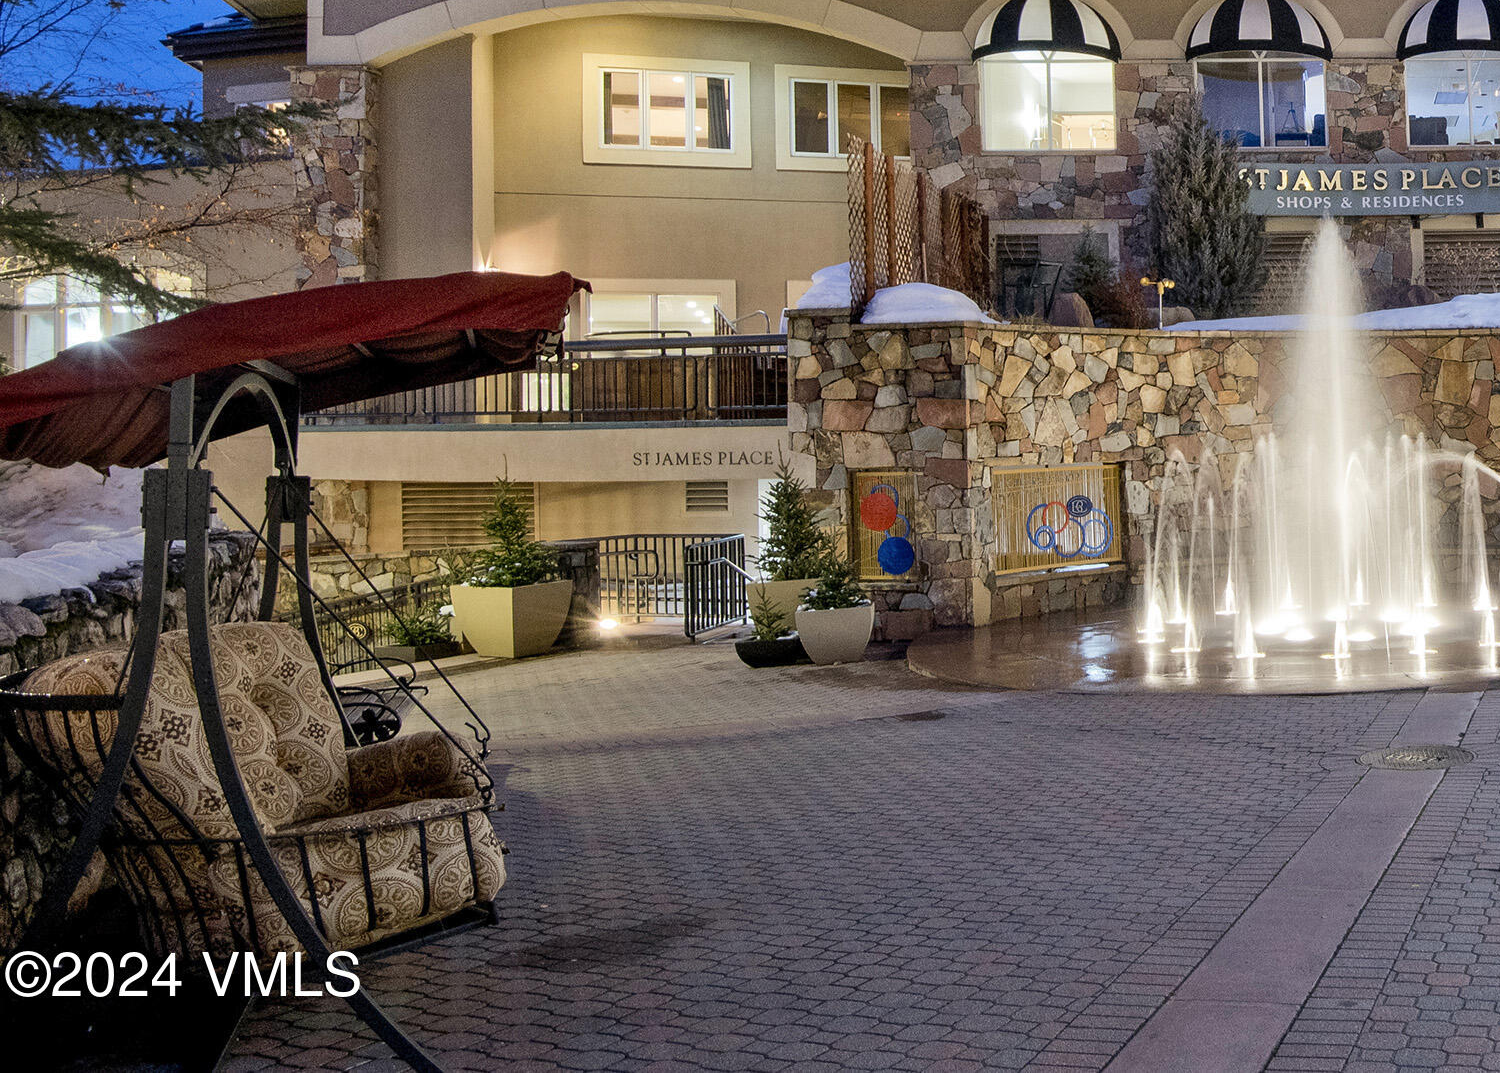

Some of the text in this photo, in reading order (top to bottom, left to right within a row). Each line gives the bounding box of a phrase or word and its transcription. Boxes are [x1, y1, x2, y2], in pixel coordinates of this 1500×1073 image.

[1239, 168, 1270, 191] ST
[1276, 170, 1389, 192] JAMES
[1276, 194, 1465, 209] SHOPS & RESIDENCES
[633, 451, 774, 466] ST JAMES PLACE
